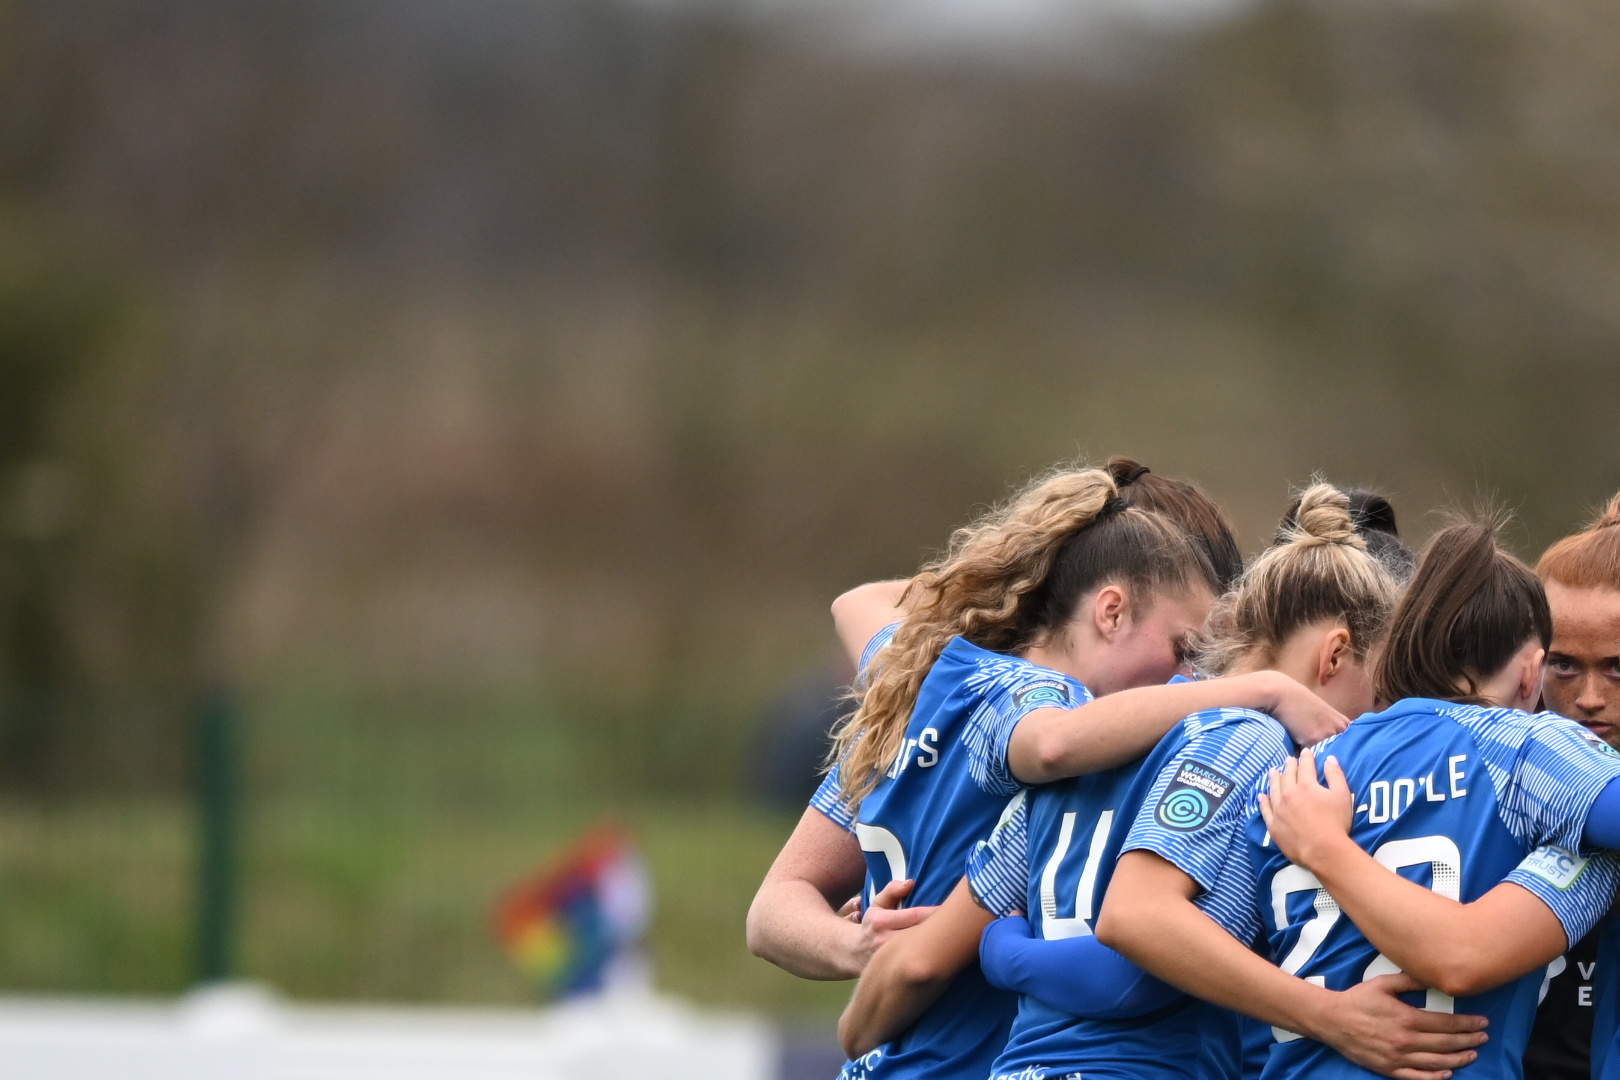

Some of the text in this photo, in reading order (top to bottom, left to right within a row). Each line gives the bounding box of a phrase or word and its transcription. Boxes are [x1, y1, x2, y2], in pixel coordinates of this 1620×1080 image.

[1180, 770, 1226, 796] WOMEN'S
[1193, 766, 1230, 789] BARCLAYS
[1526, 857, 1566, 880] TRUST
